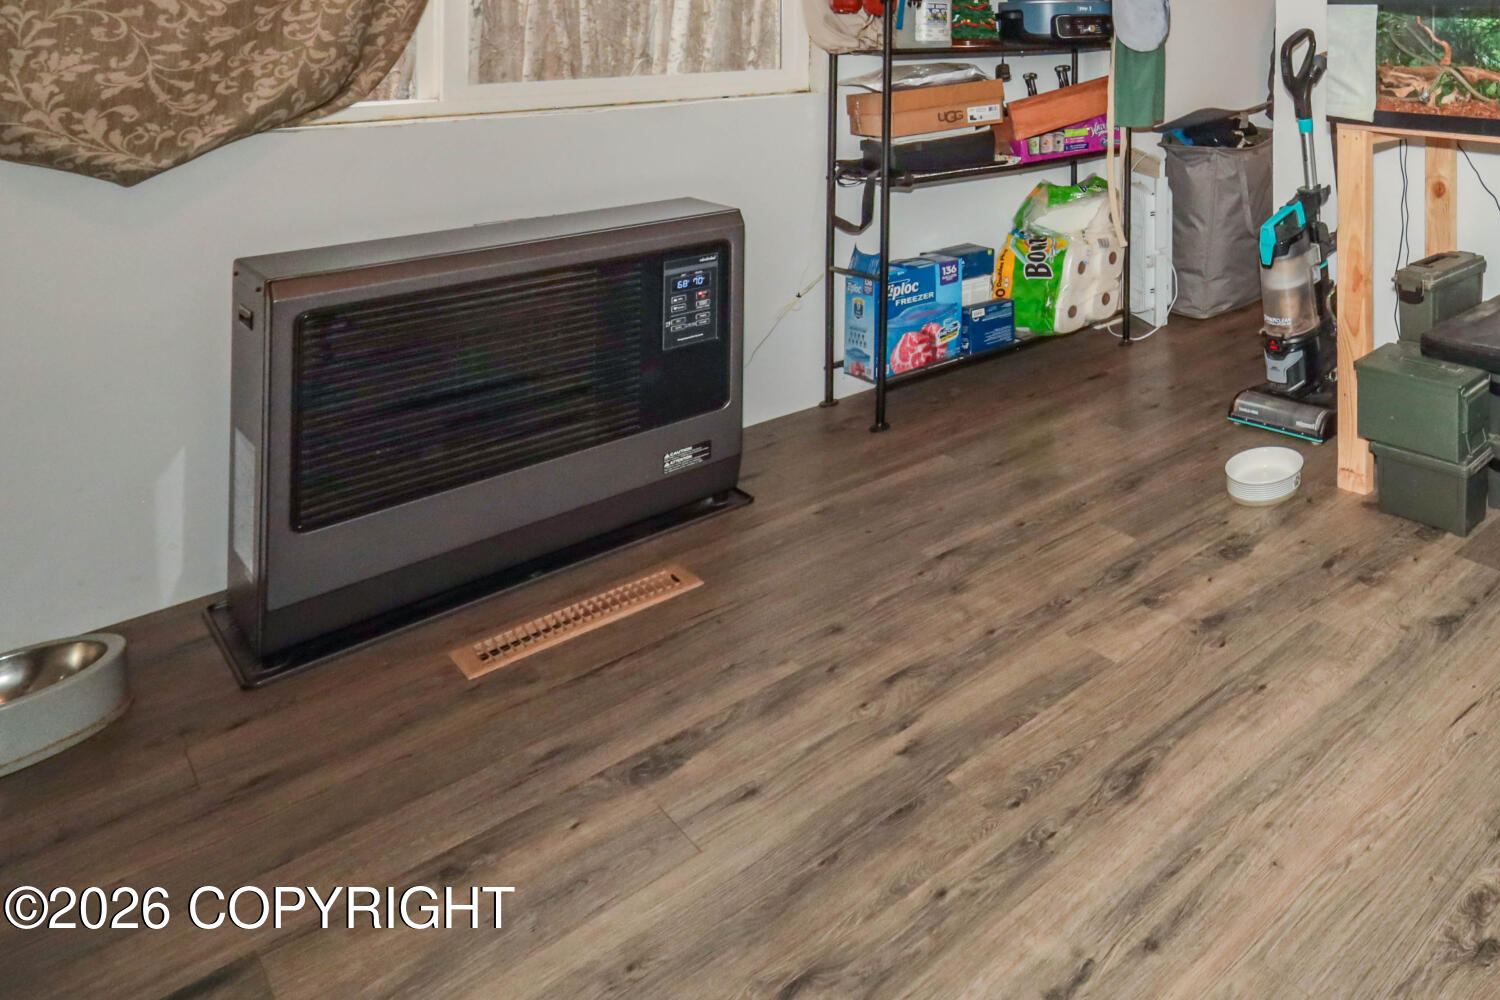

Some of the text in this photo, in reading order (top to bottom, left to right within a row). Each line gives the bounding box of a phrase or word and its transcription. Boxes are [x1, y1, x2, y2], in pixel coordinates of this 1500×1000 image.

[937, 110, 964, 123] UGG
[941, 264, 957, 276] 136
[895, 291, 935, 307] FREEZER
